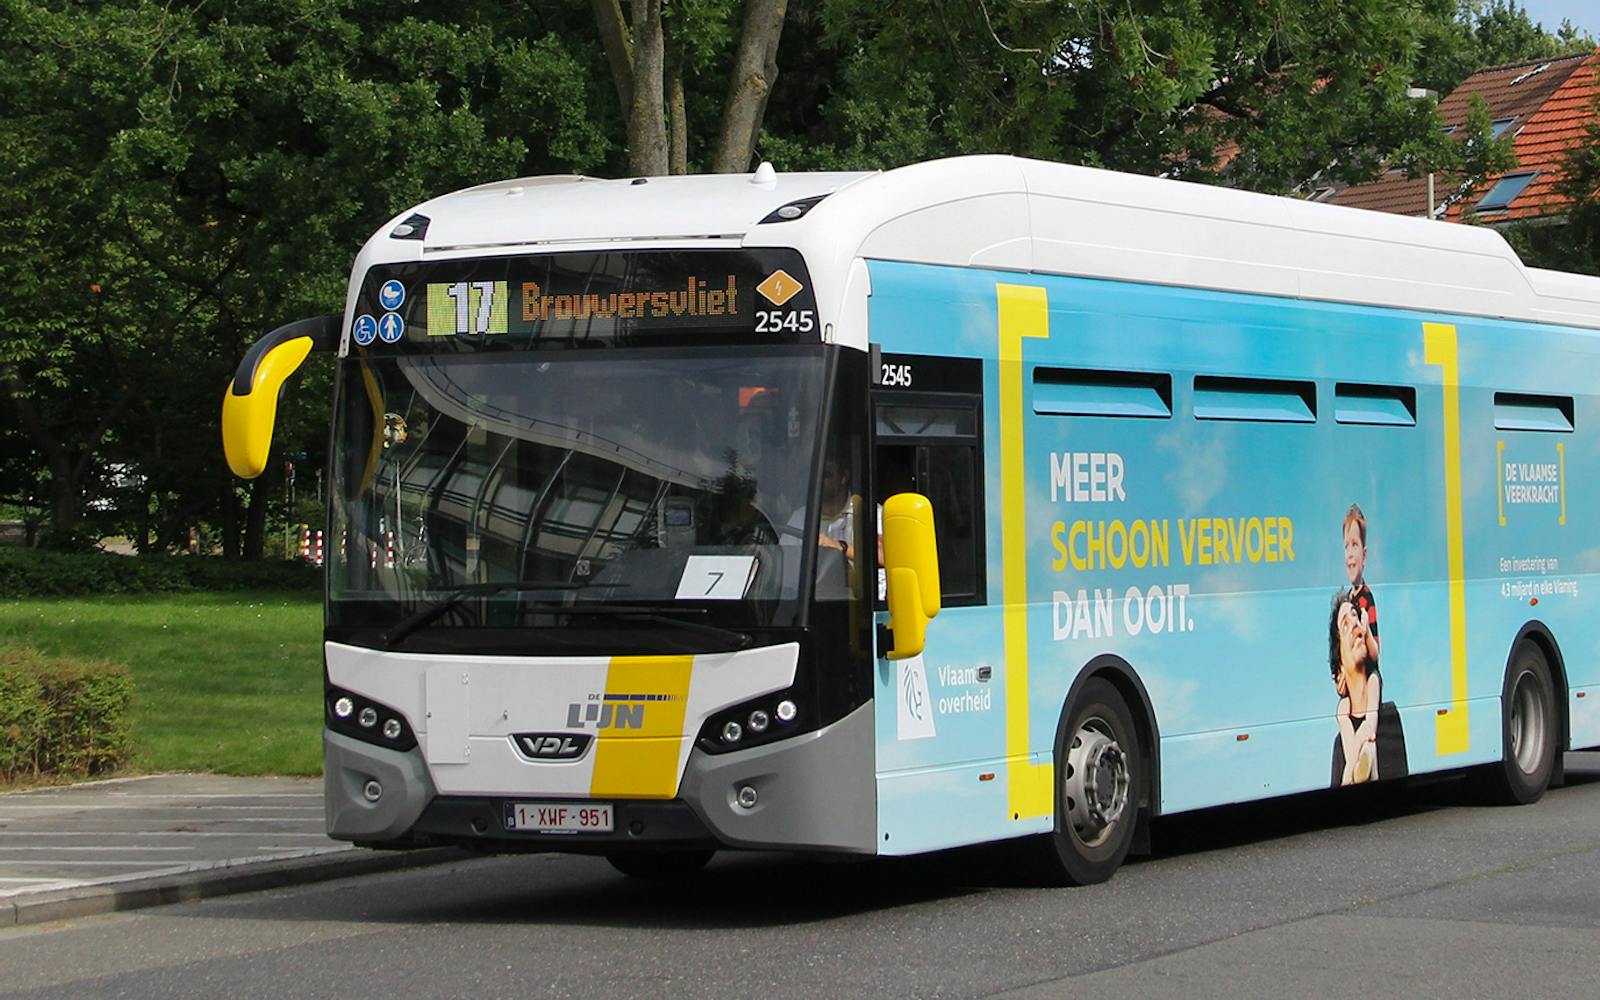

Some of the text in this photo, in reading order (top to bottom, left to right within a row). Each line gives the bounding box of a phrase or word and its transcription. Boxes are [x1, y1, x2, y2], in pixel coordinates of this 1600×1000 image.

[447, 275, 738, 334] 17 Brouwersvliet
[755, 310, 814, 333] 2545
[881, 363, 912, 387] 2545
[1050, 452, 1126, 502] MEER
[1505, 463, 1557, 482] DE VLAAMSE
[1504, 485, 1559, 504] VEERKRACHT
[1051, 516, 1295, 572] SCHOON VERVOER
[1512, 556, 1546, 575] investering
[704, 572, 724, 595] 7
[1053, 584, 1194, 641] DAN OOIT.
[938, 687, 991, 714] overheid
[566, 703, 645, 729] LIJN
[522, 737, 579, 754] VDL
